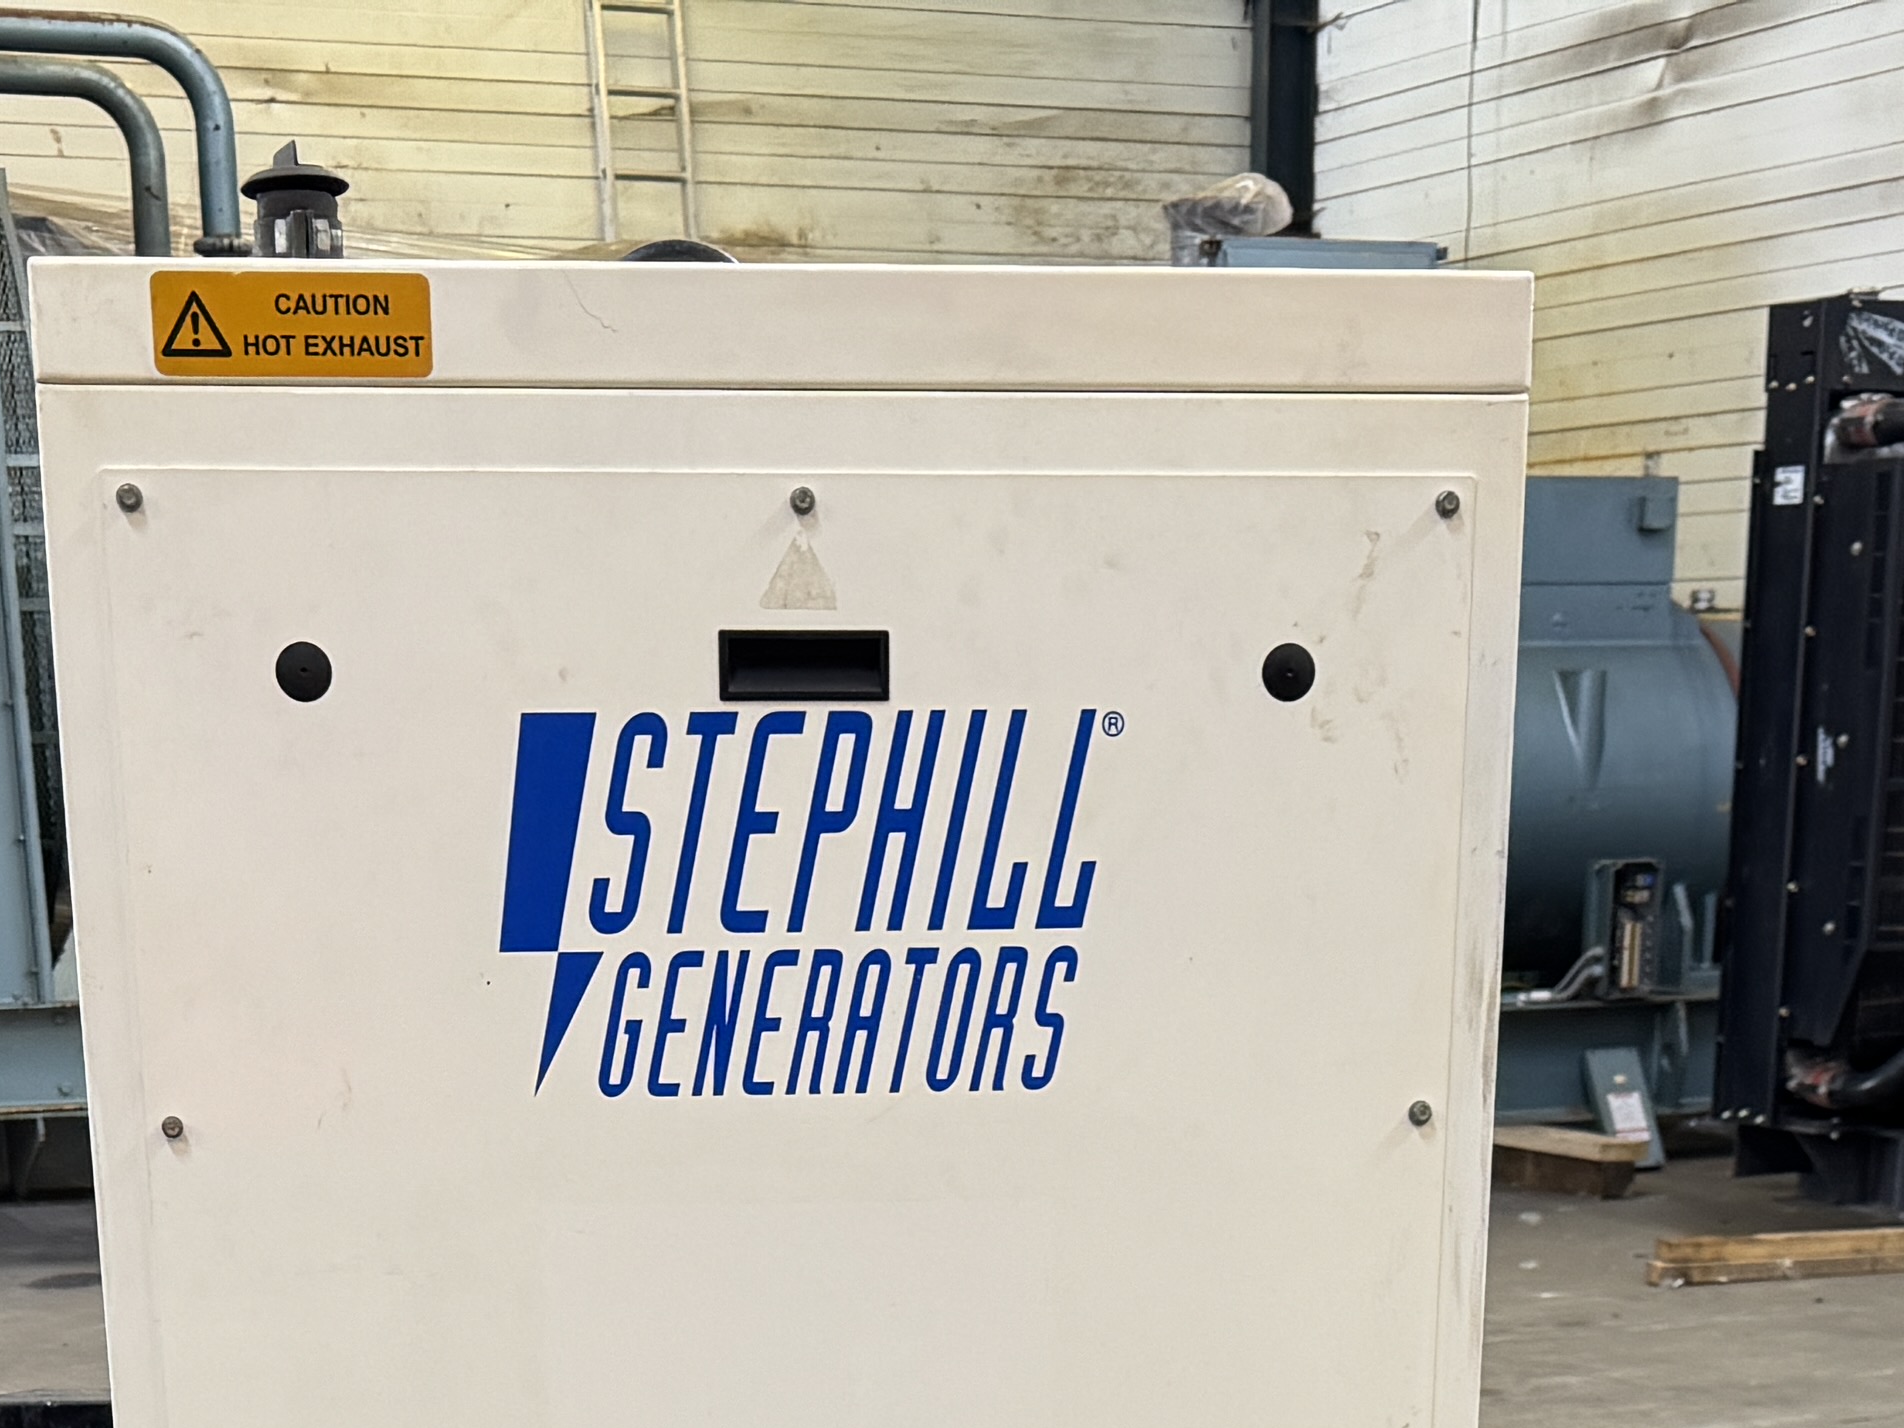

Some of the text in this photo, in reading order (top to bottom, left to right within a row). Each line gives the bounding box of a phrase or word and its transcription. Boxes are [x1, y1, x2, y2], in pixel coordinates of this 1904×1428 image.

[274, 293, 390, 316] CAUTION
[243, 334, 425, 358] HOT EXHAUST
[598, 945, 1079, 1097] GENERATORS
